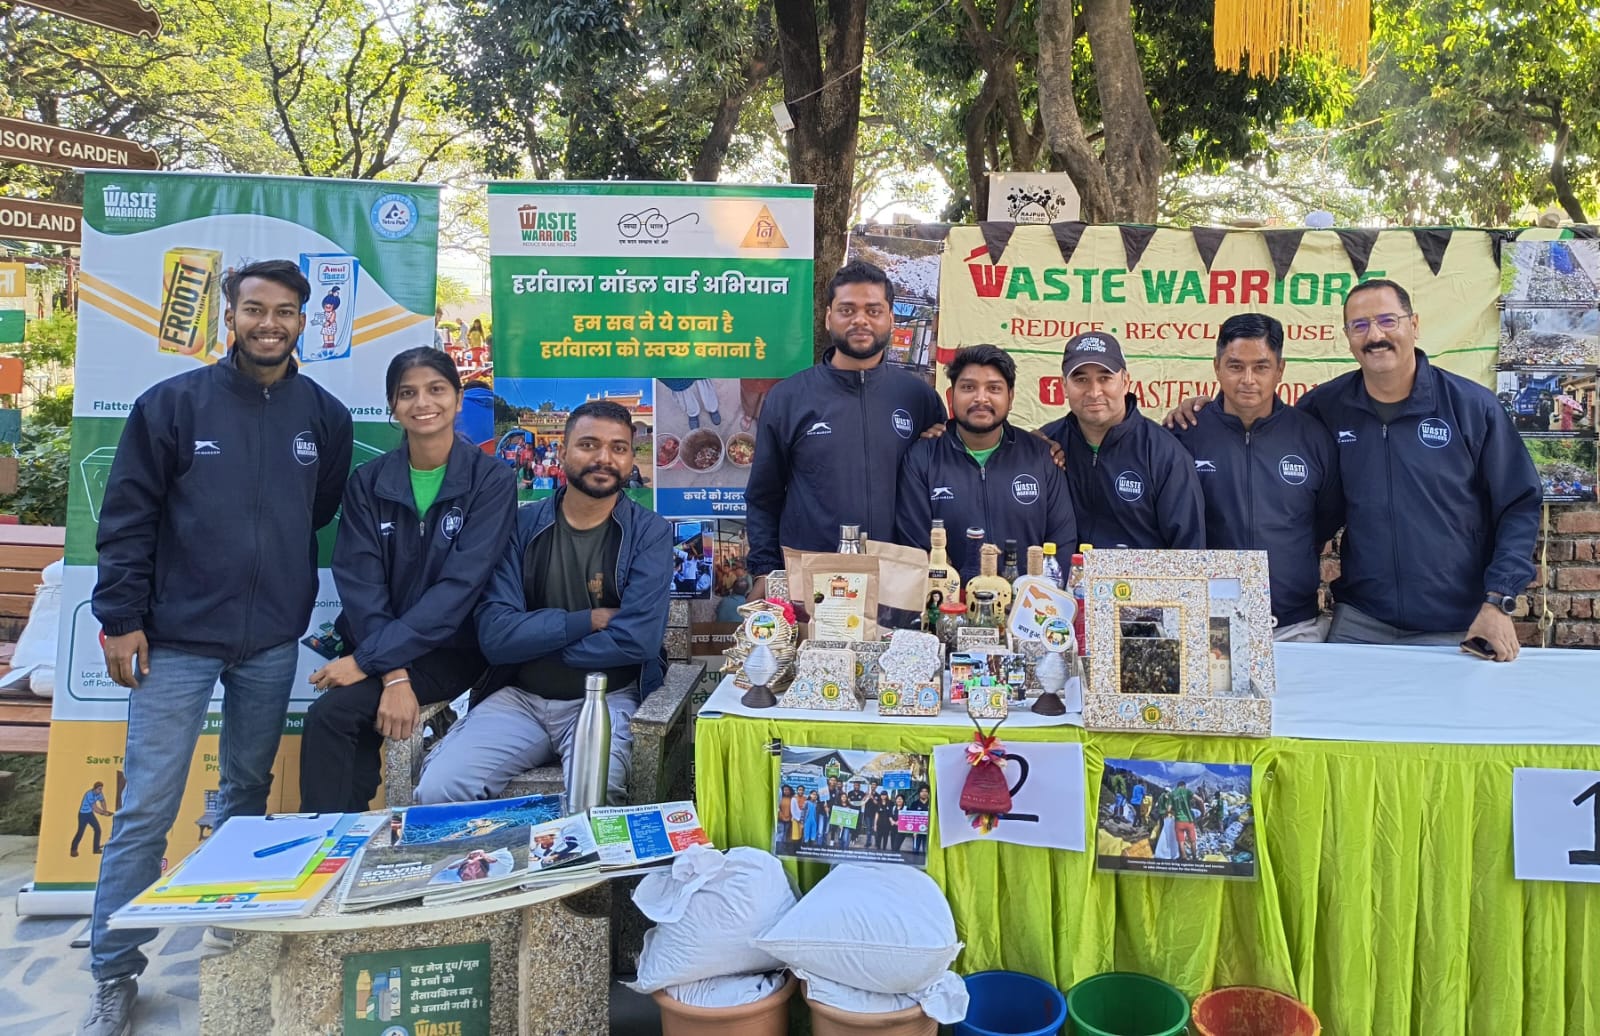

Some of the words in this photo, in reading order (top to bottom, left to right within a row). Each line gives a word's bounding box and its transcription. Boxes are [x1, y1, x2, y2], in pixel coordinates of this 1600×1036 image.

[58, 140, 128, 166] GARDEN
[103, 190, 157, 208] WASTE
[104, 206, 157, 218] WARRIORS
[518, 210, 577, 230] WASTE
[521, 229, 577, 242] WARRIORS
[598, 268, 659, 294] मॉडल
[662, 269, 700, 295] वार्ड
[702, 269, 789, 295] अभियान
[967, 262, 1127, 304] WASTE
[163, 263, 207, 346] FROOTI
[572, 315, 602, 333] हम
[605, 315, 635, 332] सब
[638, 310, 656, 332] ने
[658, 310, 674, 332] ये
[677, 316, 719, 332] ठाना
[721, 309, 735, 334] है
[1125, 322, 1222, 341] RECYCL
[1286, 324, 1335, 341] USE
[615, 336, 641, 358] को
[643, 341, 690, 358] स्वच्छ
[693, 342, 751, 358] बनाना
[754, 336, 767, 360] है
[1421, 425, 1448, 435] WASTE
[1282, 462, 1305, 472] WASTE
[1014, 482, 1038, 492] WASTE
[1119, 479, 1142, 489] WASTE
[683, 488, 707, 501] कचरे
[708, 488, 721, 501] को
[81, 671, 103, 679] Local
[83, 679, 95, 687] off
[97, 679, 120, 687] Poin
[86, 756, 111, 765] Save
[361, 864, 433, 877] SOLVING
[410, 965, 424, 974] यह
[410, 976, 420, 987] के
[442, 973, 455, 984] को
[410, 1004, 420, 1014] के
[414, 1020, 462, 1036] WASTE
